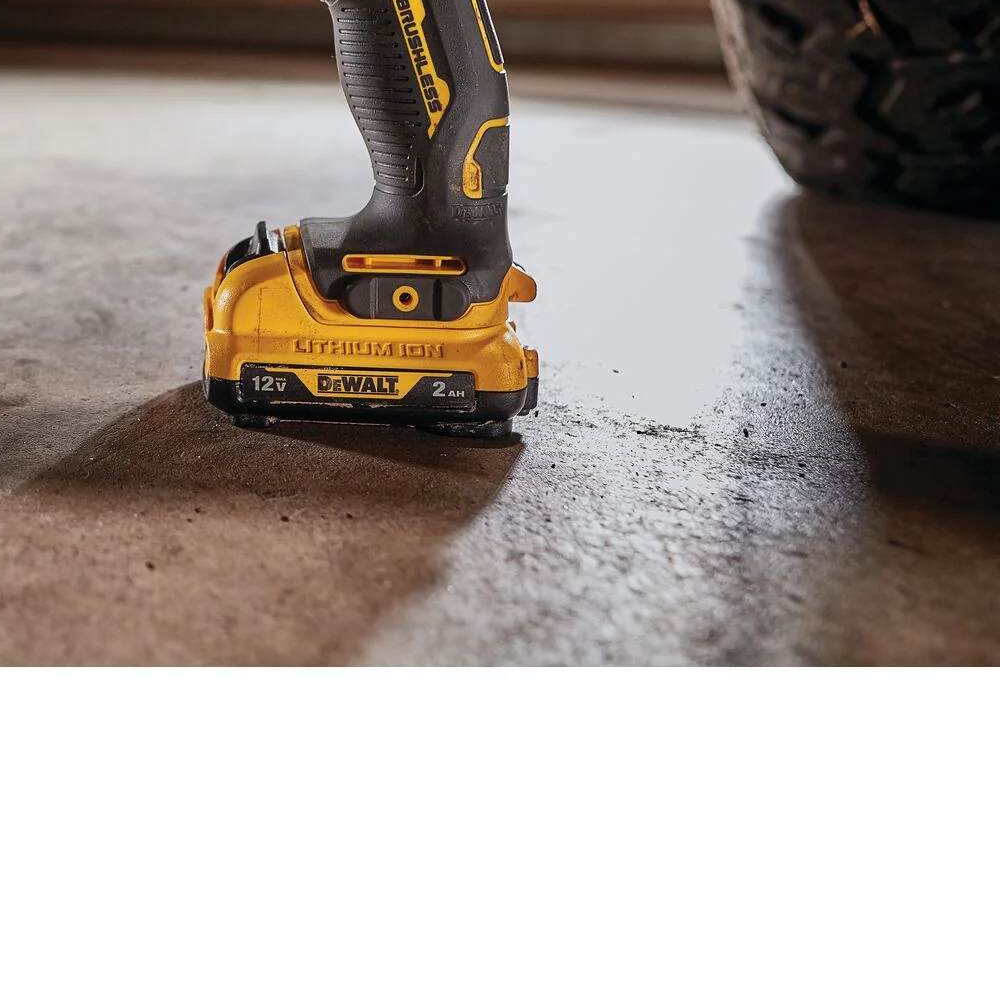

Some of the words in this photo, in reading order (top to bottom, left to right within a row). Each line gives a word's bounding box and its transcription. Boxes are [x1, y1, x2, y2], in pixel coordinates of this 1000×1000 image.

[292, 338, 393, 357] LITHIUM
[399, 342, 445, 359] ION
[317, 375, 399, 394] DEWALT
